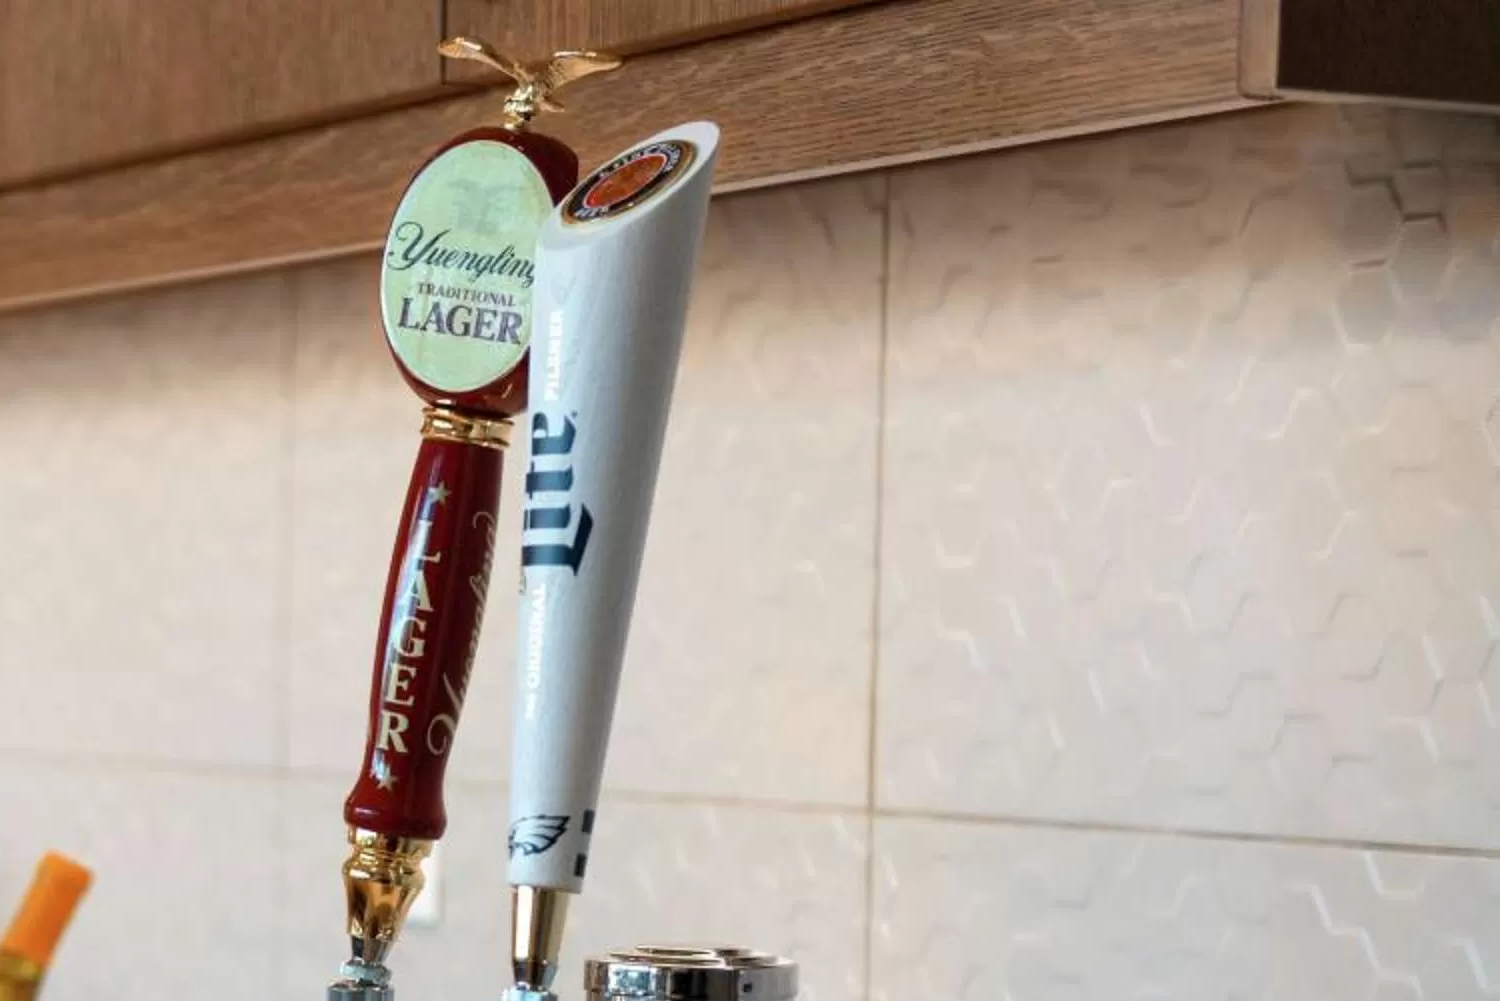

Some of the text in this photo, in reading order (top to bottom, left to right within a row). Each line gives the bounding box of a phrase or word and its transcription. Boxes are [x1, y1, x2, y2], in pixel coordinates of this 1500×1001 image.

[397, 297, 523, 345] LAGER
[417, 282, 517, 307] TRADITIONAL
[522, 411, 594, 577] Lite
[378, 519, 442, 754] LAGER
